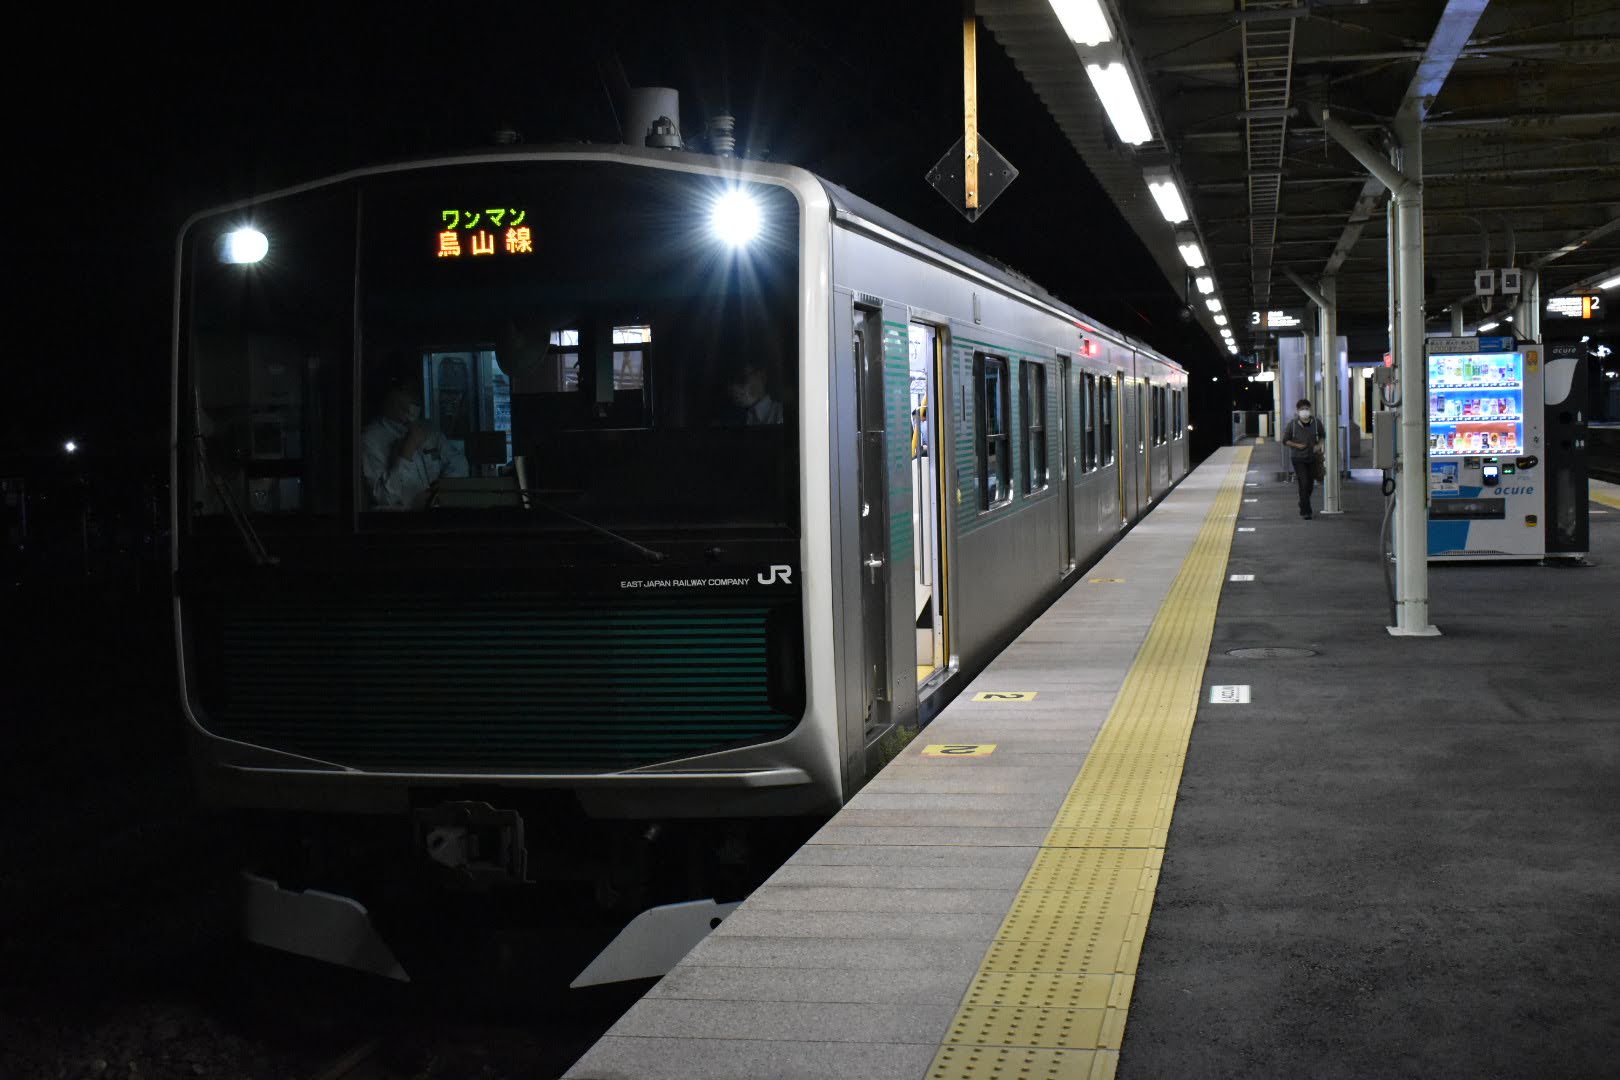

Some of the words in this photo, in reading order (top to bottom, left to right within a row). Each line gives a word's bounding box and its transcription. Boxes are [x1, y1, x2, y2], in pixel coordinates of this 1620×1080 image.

[442, 209, 525, 229] ワンマン
[438, 227, 532, 257] 烏山線
[1591, 296, 1600, 310] 2
[1251, 311, 1261, 325] 3
[1494, 486, 1534, 496] acure
[757, 565, 792, 585] JR
[620, 580, 643, 588] EAST
[643, 579, 671, 588] JAPAN
[672, 579, 707, 587] RAILWAY
[708, 578, 750, 587] COMPANY
